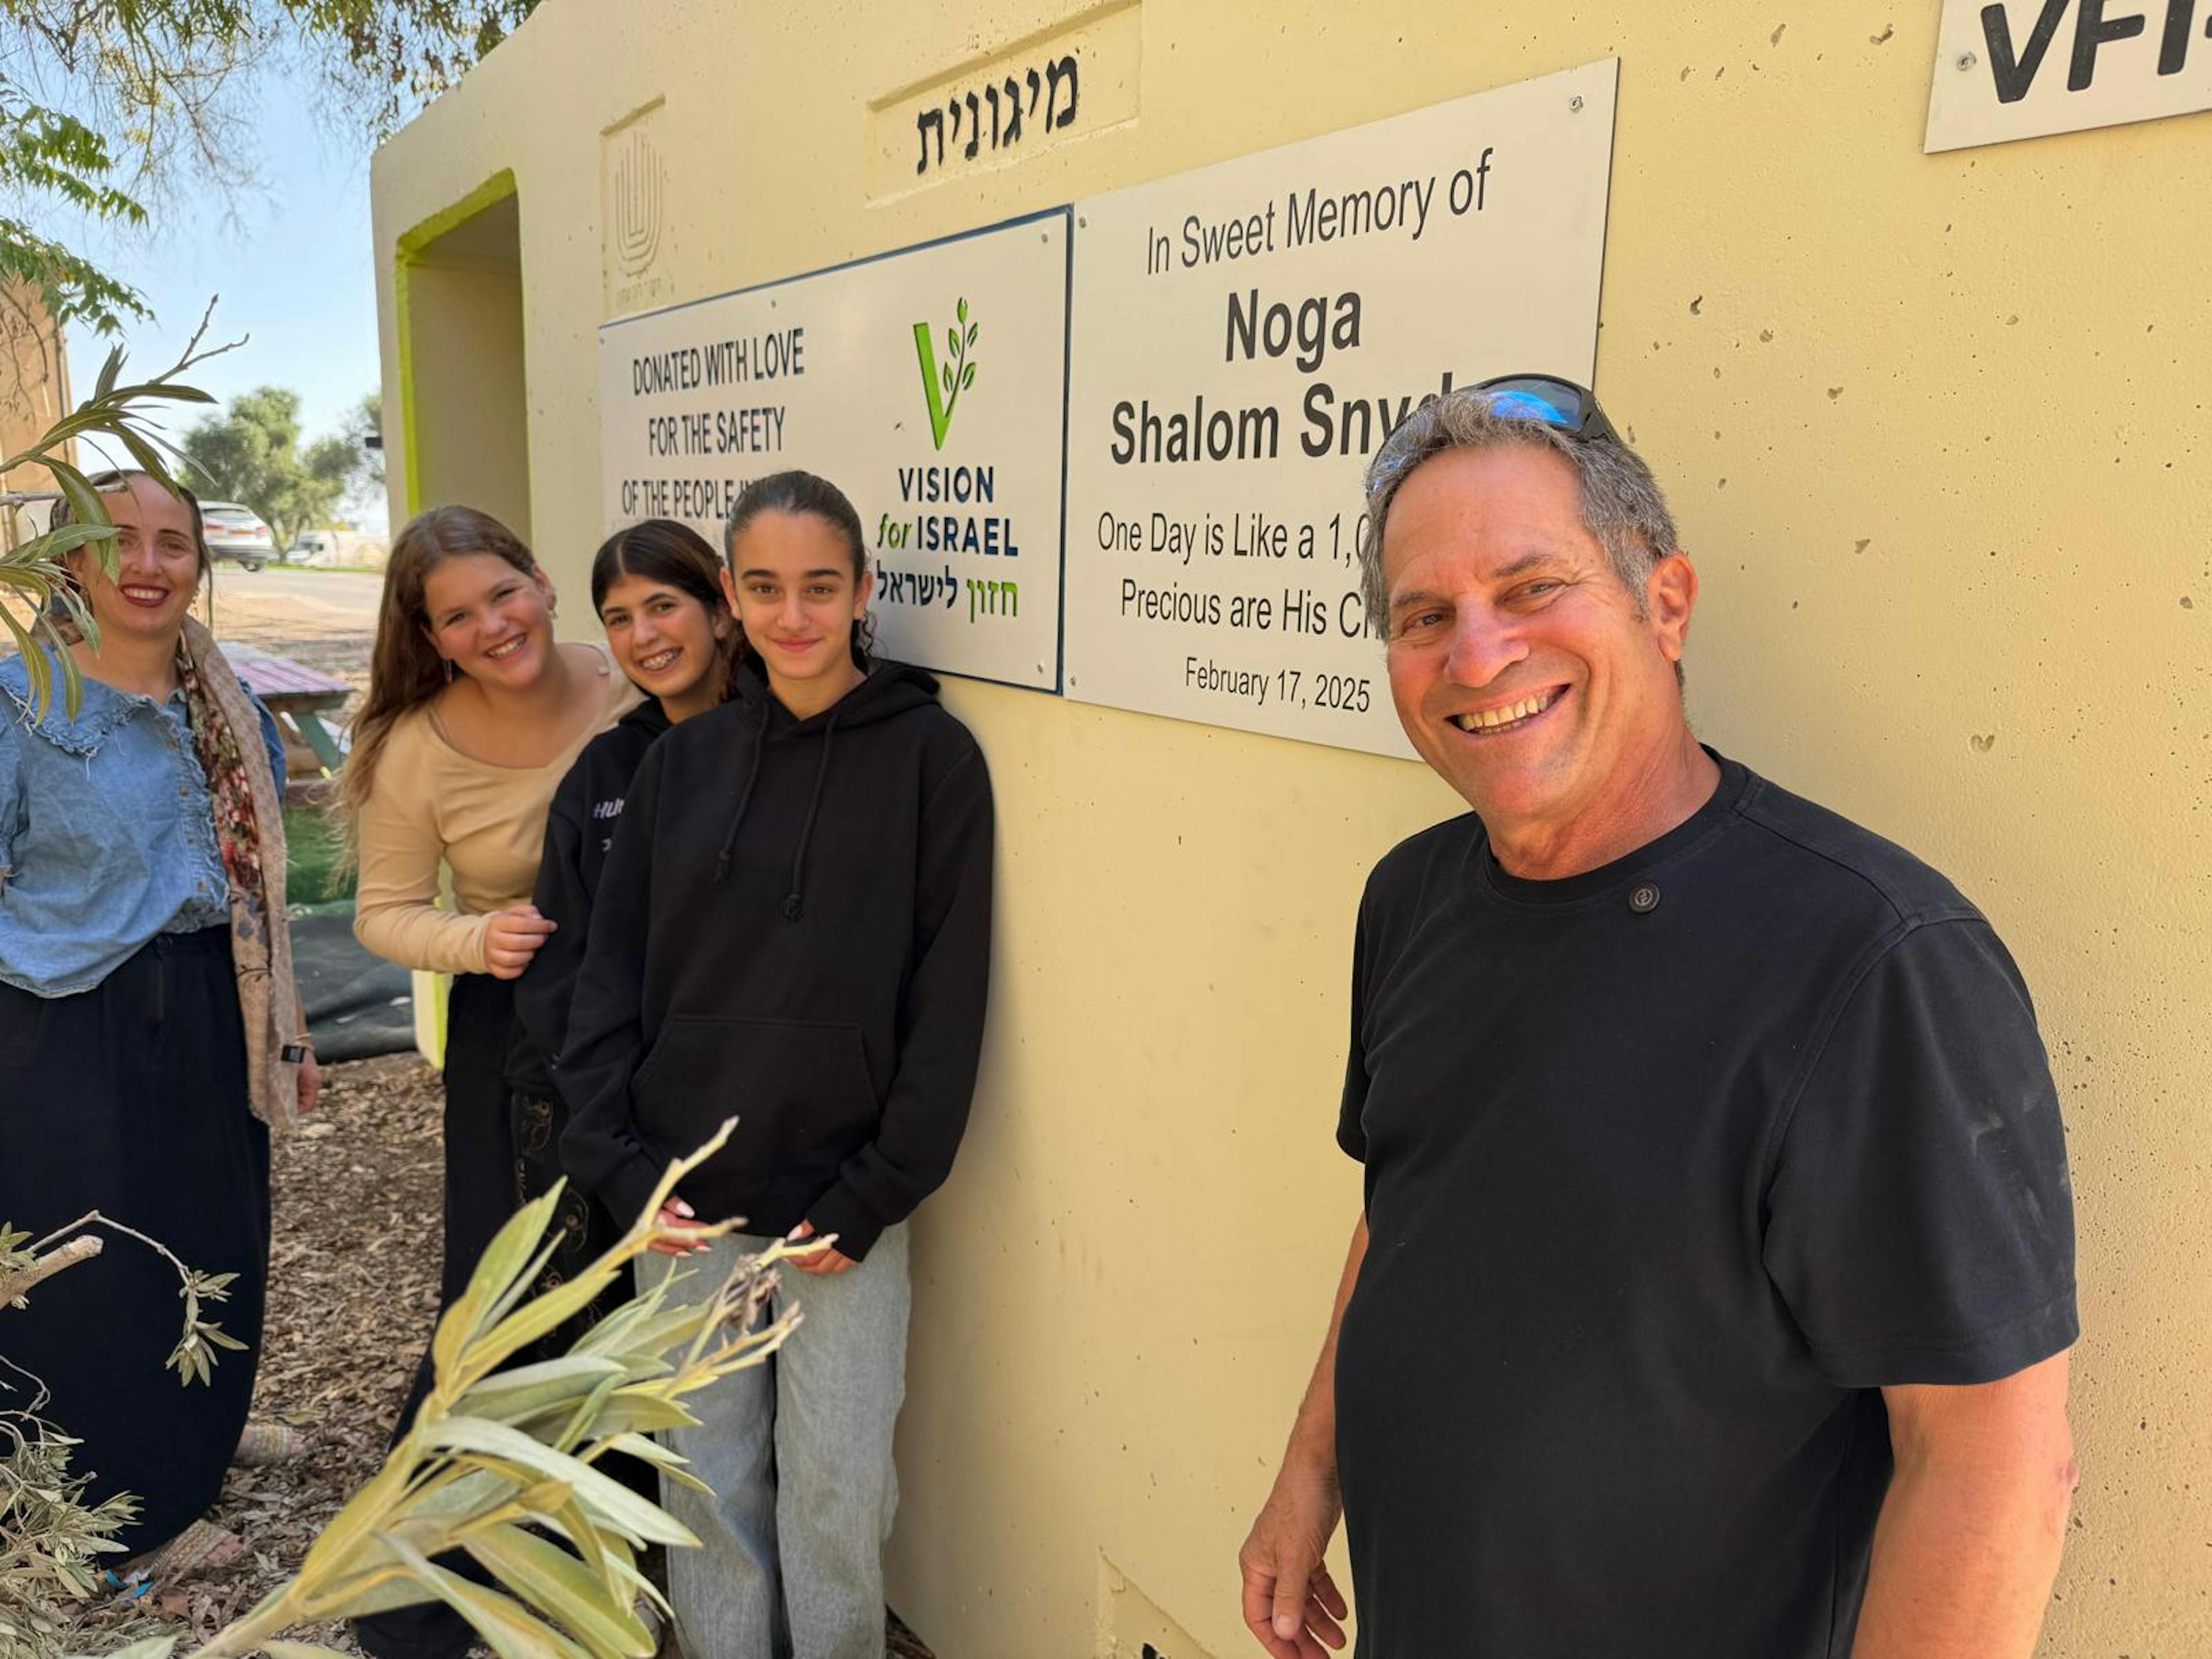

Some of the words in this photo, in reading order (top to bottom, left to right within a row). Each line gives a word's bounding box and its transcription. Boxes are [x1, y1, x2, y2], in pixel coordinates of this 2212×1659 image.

[917, 56, 1080, 175] מיגונית
[1147, 226, 1170, 275] In
[1181, 200, 1275, 268] Sweet
[1287, 176, 1436, 248] Memory
[1449, 147, 1494, 215] of
[1225, 288, 1361, 373] Noga
[633, 347, 701, 396] DONATED
[704, 338, 748, 387] WITH
[753, 327, 804, 381] LOVE
[649, 416, 679, 456] FOR
[681, 412, 712, 455] THE
[717, 405, 785, 454] SAFETY
[1111, 395, 1279, 465] Shalom
[622, 479, 639, 516] OF
[642, 479, 669, 517] THE
[674, 479, 734, 520] PEOPLE
[899, 466, 994, 503] VISION
[877, 513, 913, 549] for
[917, 516, 1018, 556] ISRAEL
[1098, 512, 1142, 551] One
[1151, 512, 1196, 565] Day
[1205, 513, 1224, 556] is
[1234, 513, 1287, 558] Like
[1298, 525, 1314, 559] a
[876, 559, 958, 609] לישראל
[966, 578, 1017, 624] חזון
[1122, 578, 1221, 625] Precious
[1230, 596, 1272, 630] are
[1283, 589, 1327, 635] His
[1185, 656, 1270, 706] February
[1277, 669, 1306, 709] 17,
[1315, 673, 1370, 713] 2025
